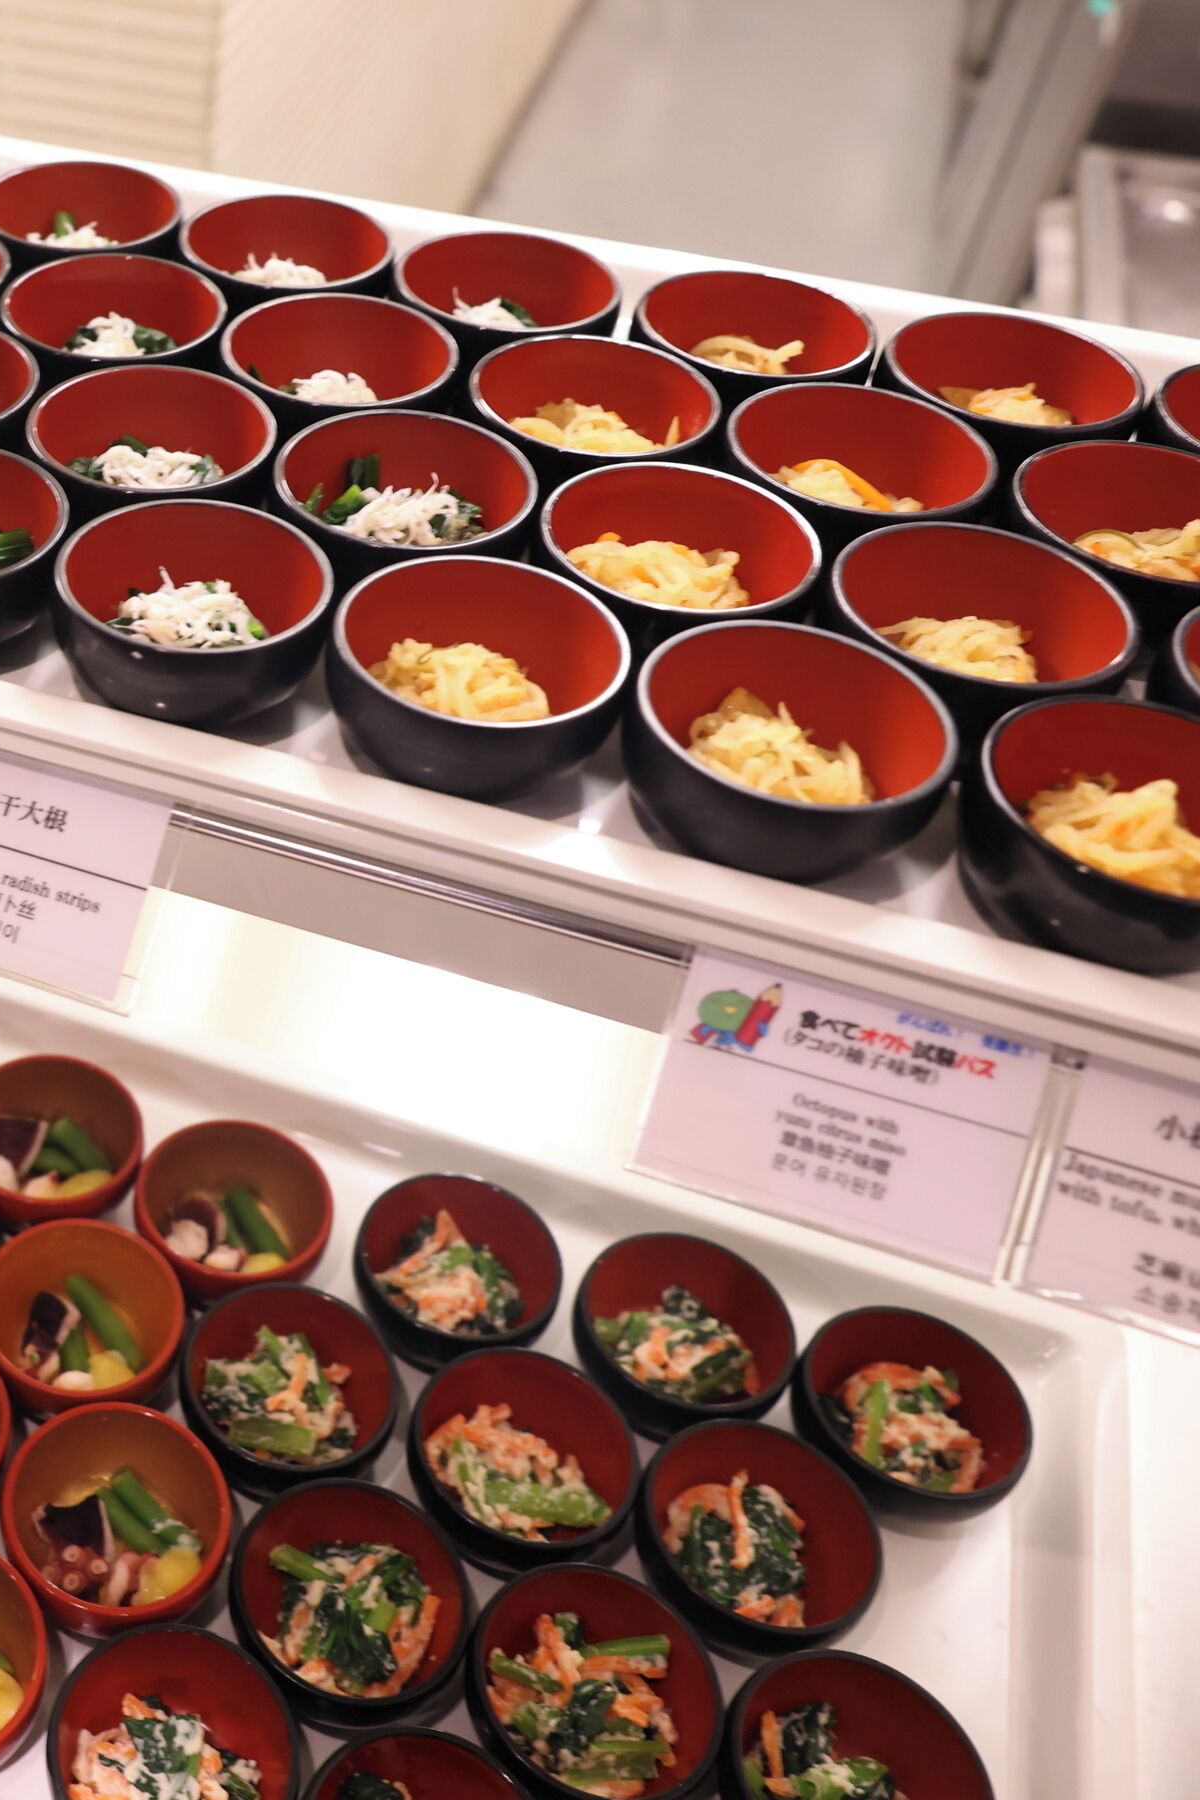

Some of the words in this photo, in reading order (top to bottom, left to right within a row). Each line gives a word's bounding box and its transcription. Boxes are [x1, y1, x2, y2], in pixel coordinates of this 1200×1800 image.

[0, 873, 51, 900] radish
[53, 890, 102, 914] strips
[792, 1091, 858, 1122] Octopus
[864, 1115, 900, 1136] with
[1057, 1182, 1102, 1206] with
[1062, 1152, 1162, 1200] Japanese
